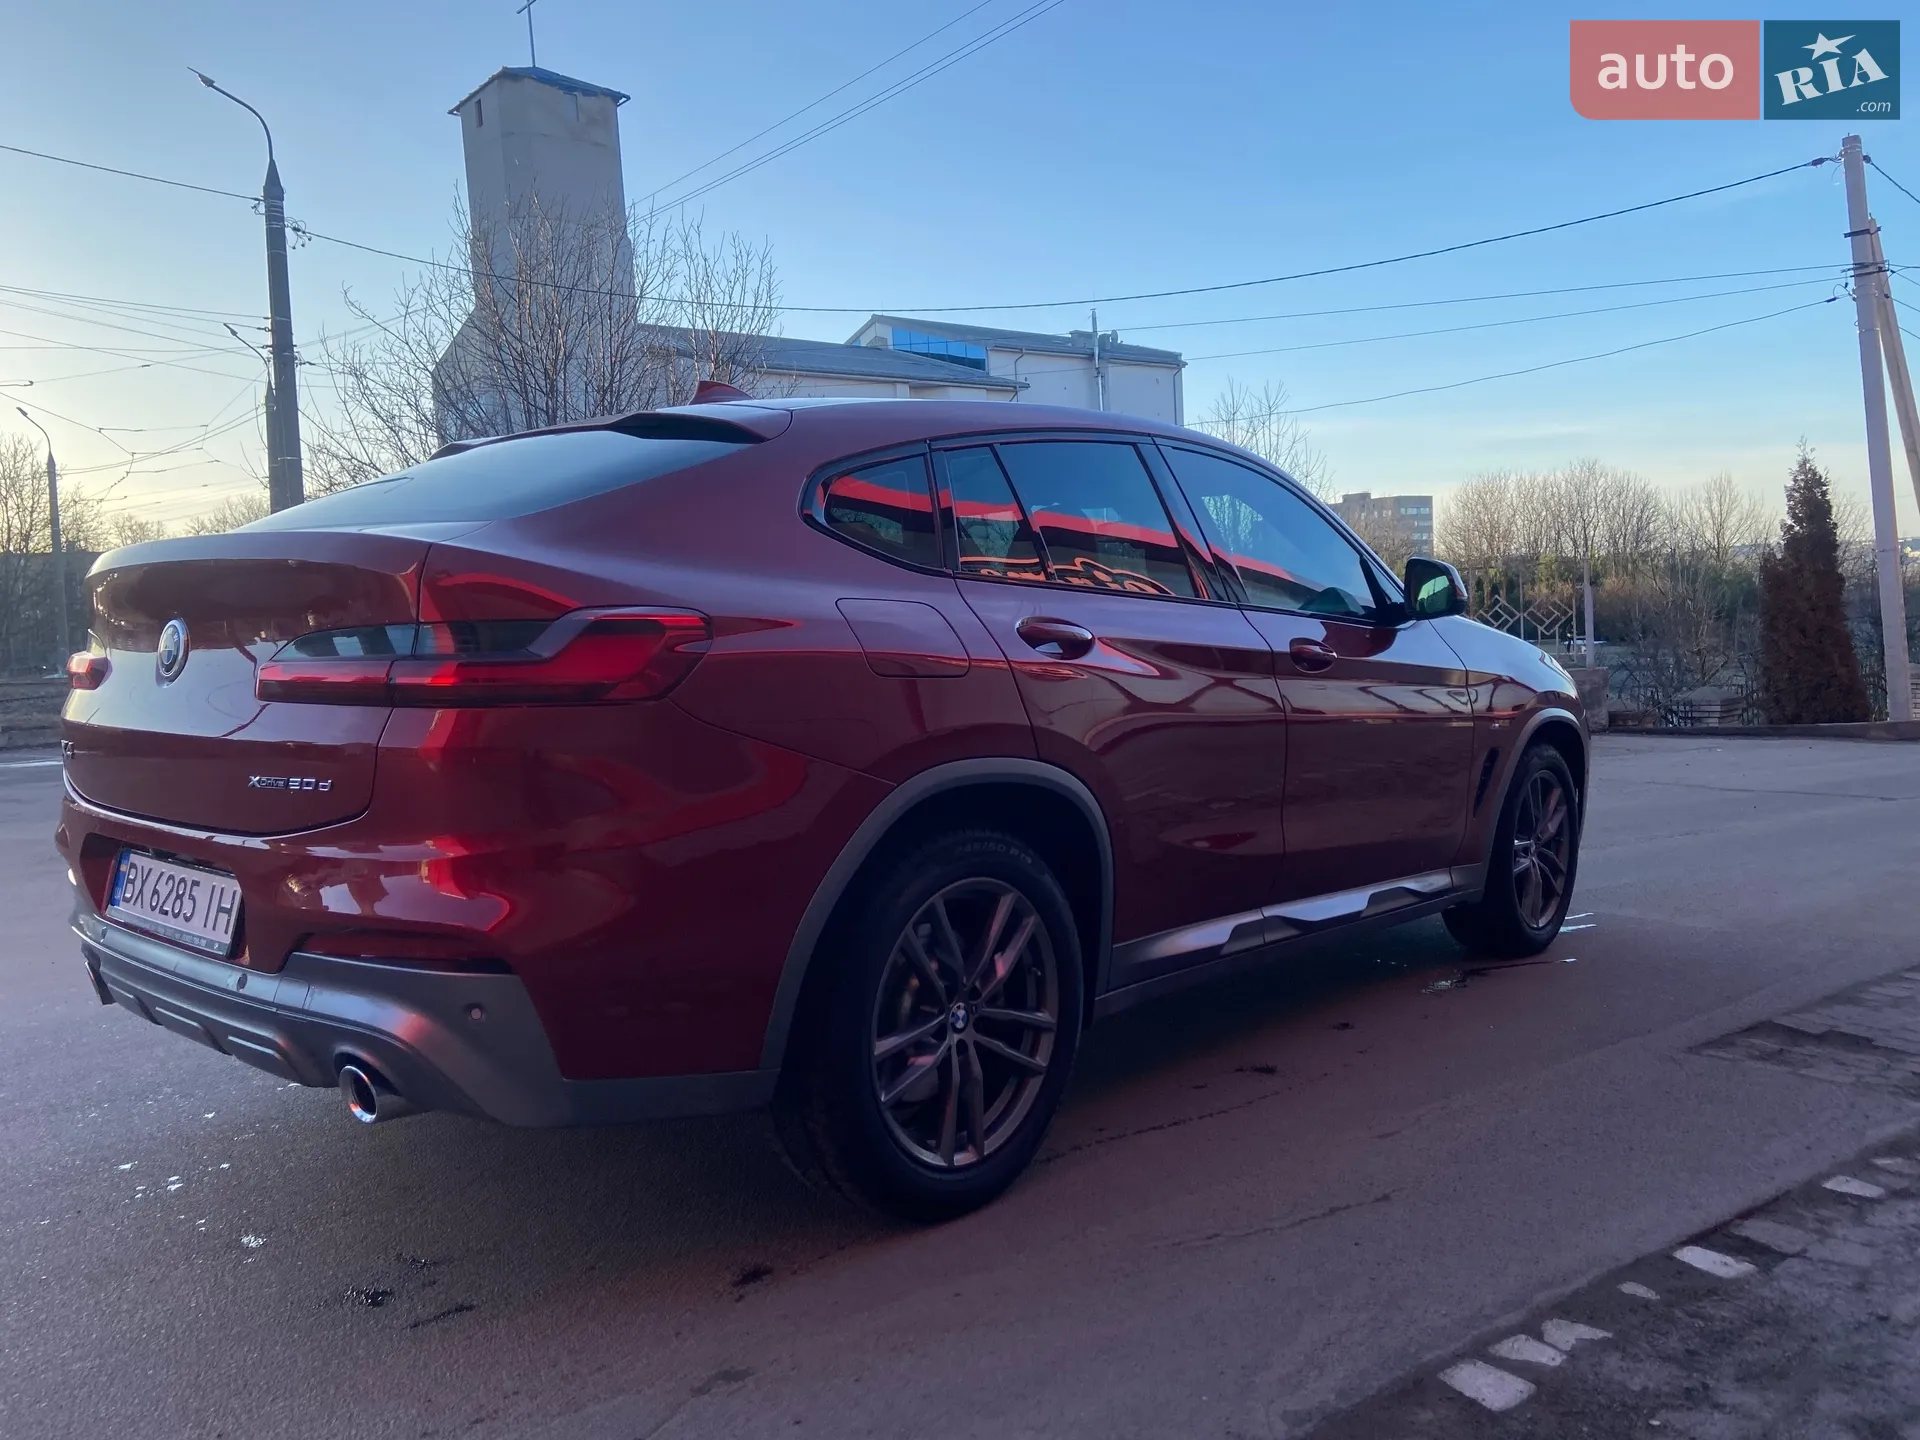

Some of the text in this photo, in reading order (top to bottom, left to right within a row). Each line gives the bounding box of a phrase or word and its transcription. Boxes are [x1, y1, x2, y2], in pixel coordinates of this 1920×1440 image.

[121, 861, 153, 909] BX
[149, 869, 201, 923] 6285
[203, 883, 238, 935] IH
